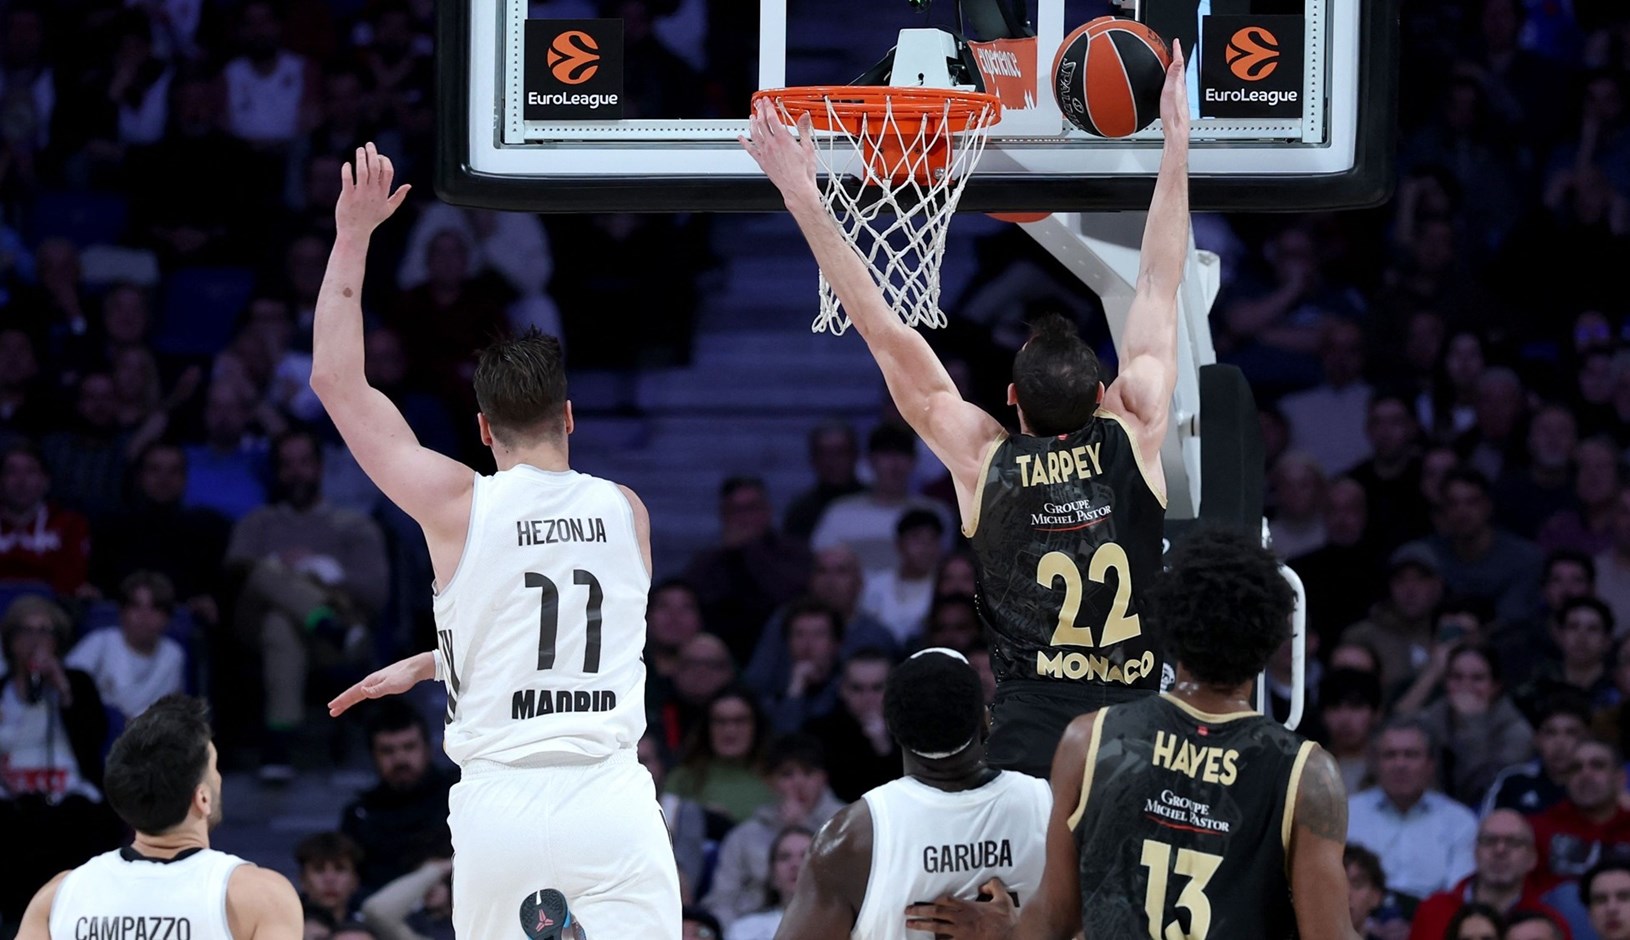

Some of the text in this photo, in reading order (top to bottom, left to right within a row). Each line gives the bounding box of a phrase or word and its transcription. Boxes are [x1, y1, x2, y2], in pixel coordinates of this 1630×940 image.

[528, 92, 618, 109] EuroLeague
[1205, 88, 1298, 106] EuroLeague
[1016, 442, 1103, 487] TARPEY
[1031, 505, 1112, 525] MICHEL PASTOR
[1043, 499, 1091, 514] GROUPE
[516, 517, 607, 546] HEZONJA
[1036, 542, 1142, 648] 22
[524, 569, 604, 674] 11
[1037, 650, 1155, 685] MONACO
[511, 689, 617, 719] MADRID
[1152, 730, 1240, 786] HAYES
[1144, 798, 1230, 833] MICHEL PASTOR
[1161, 789, 1210, 816] GROUPE
[923, 839, 1013, 874] GARUBA
[1140, 839, 1224, 940] 13
[75, 916, 192, 940] CAMPAZZO
